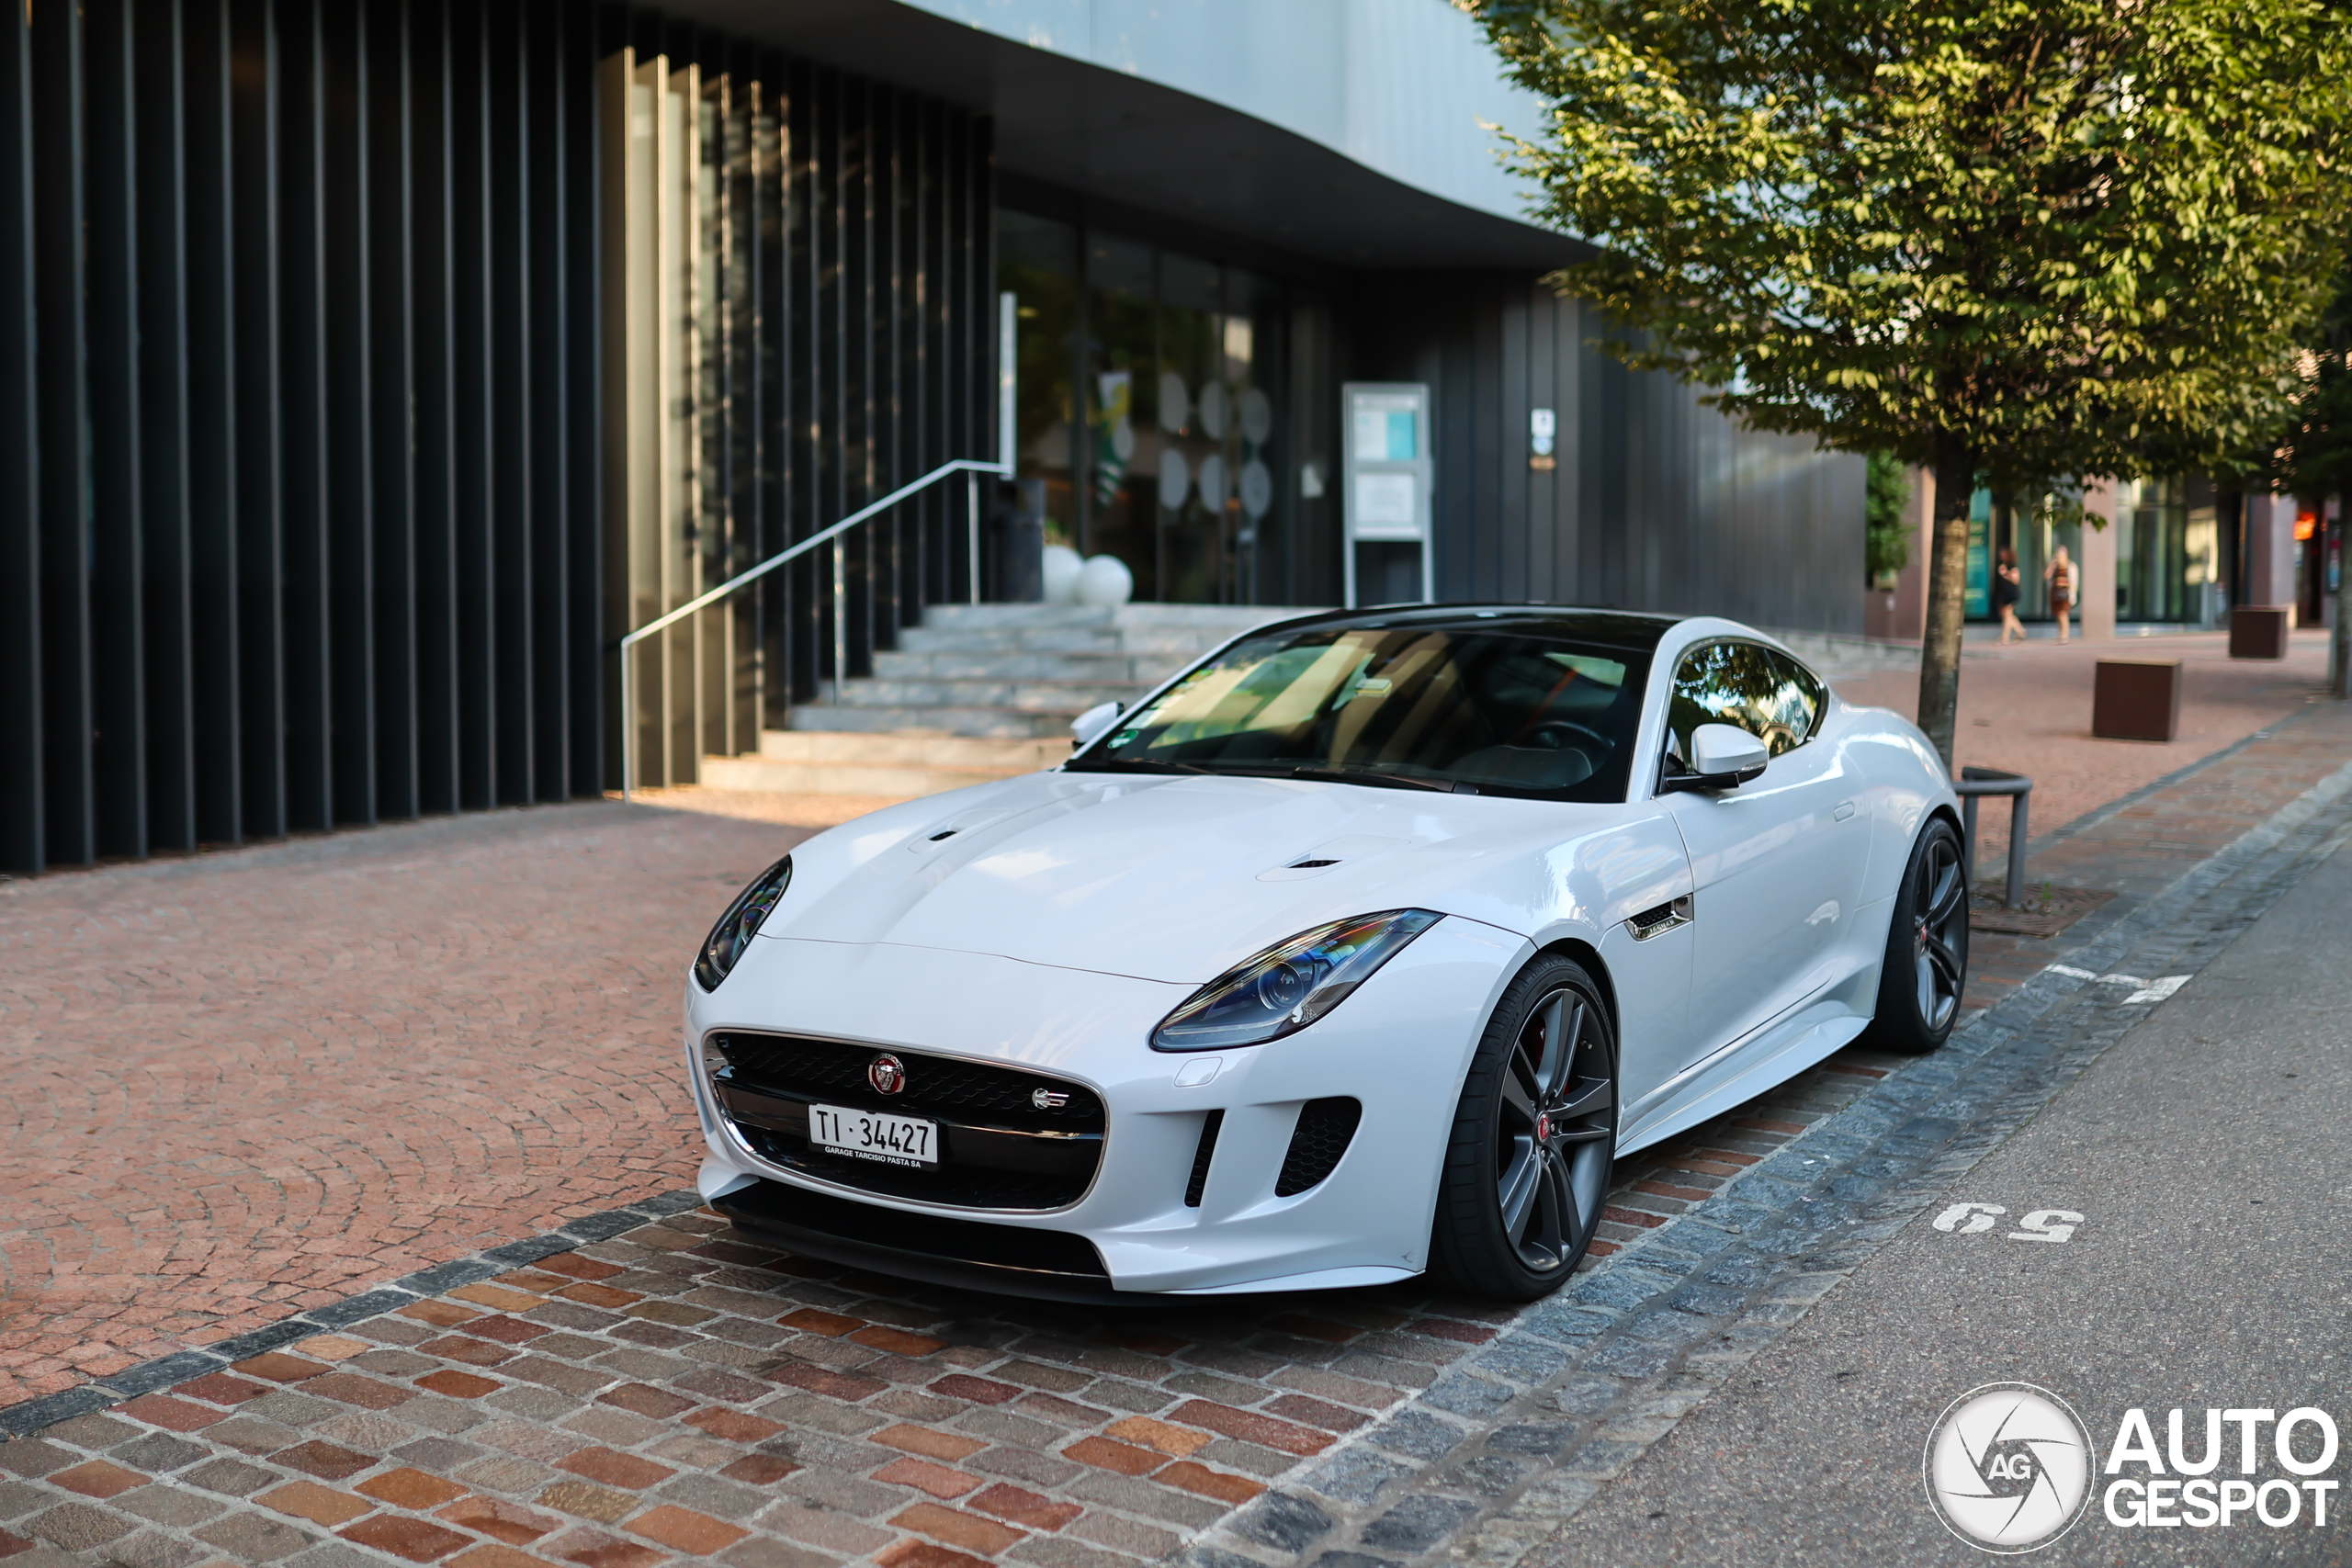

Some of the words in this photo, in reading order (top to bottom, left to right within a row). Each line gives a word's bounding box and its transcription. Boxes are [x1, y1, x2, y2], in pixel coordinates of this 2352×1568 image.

[1649, 919, 1675, 933] JAGUAR
[816, 1110, 840, 1142] TI
[859, 1117, 929, 1156] 34427
[824, 1145, 854, 1157] GARAGE
[854, 1151, 887, 1163] TARCISIO
[887, 1156, 910, 1167] PASTA
[910, 1160, 922, 1168] SA
